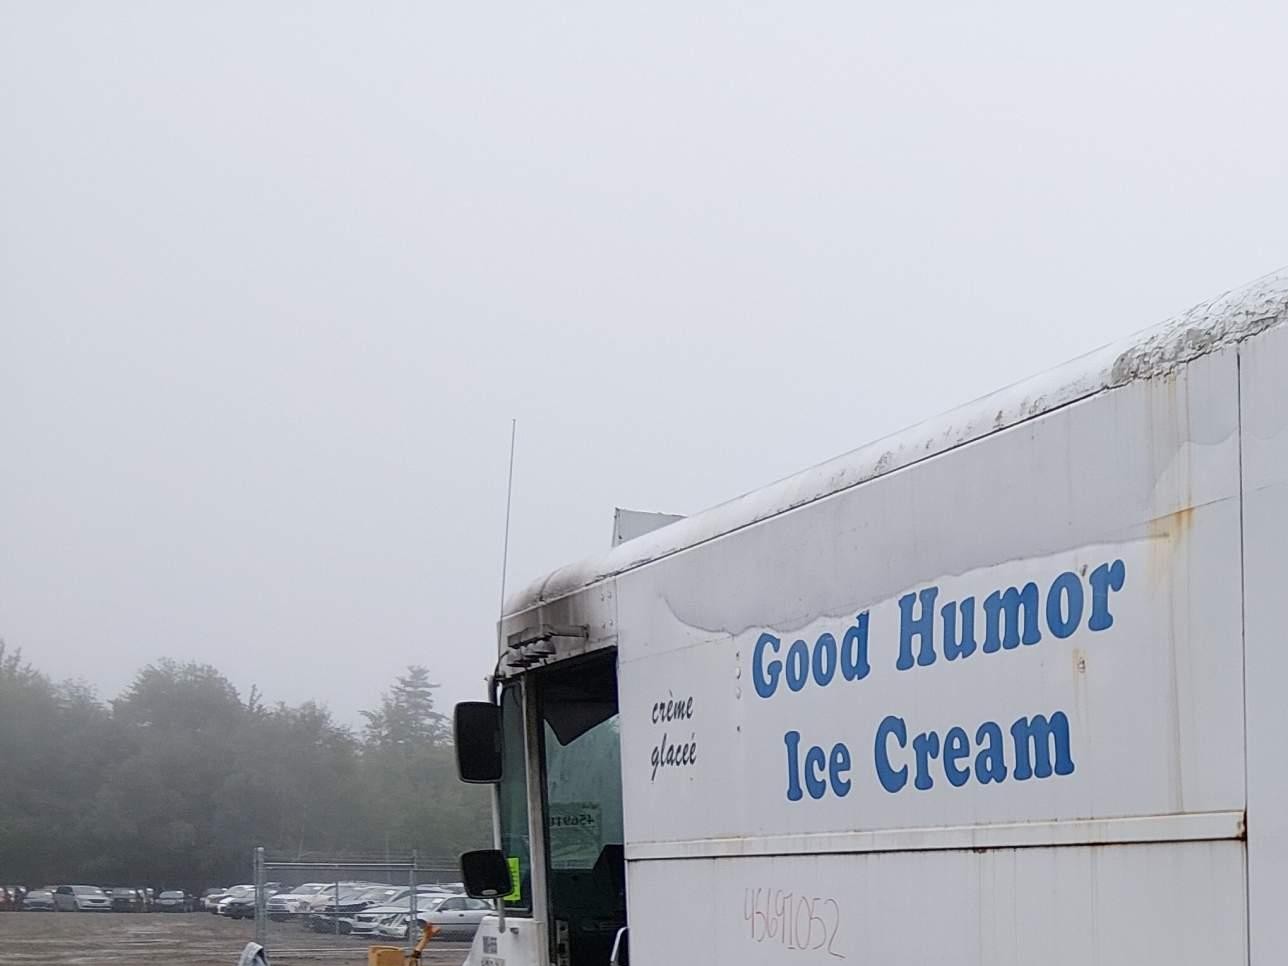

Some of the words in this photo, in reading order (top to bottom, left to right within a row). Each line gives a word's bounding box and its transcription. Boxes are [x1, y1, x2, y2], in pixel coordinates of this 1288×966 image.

[752, 608, 871, 698] Good
[896, 559, 1126, 671] Humor
[652, 689, 693, 724] crème
[784, 730, 851, 801] Ice
[874, 711, 1075, 793] Cream
[744, 887, 846, 959] 45691052
